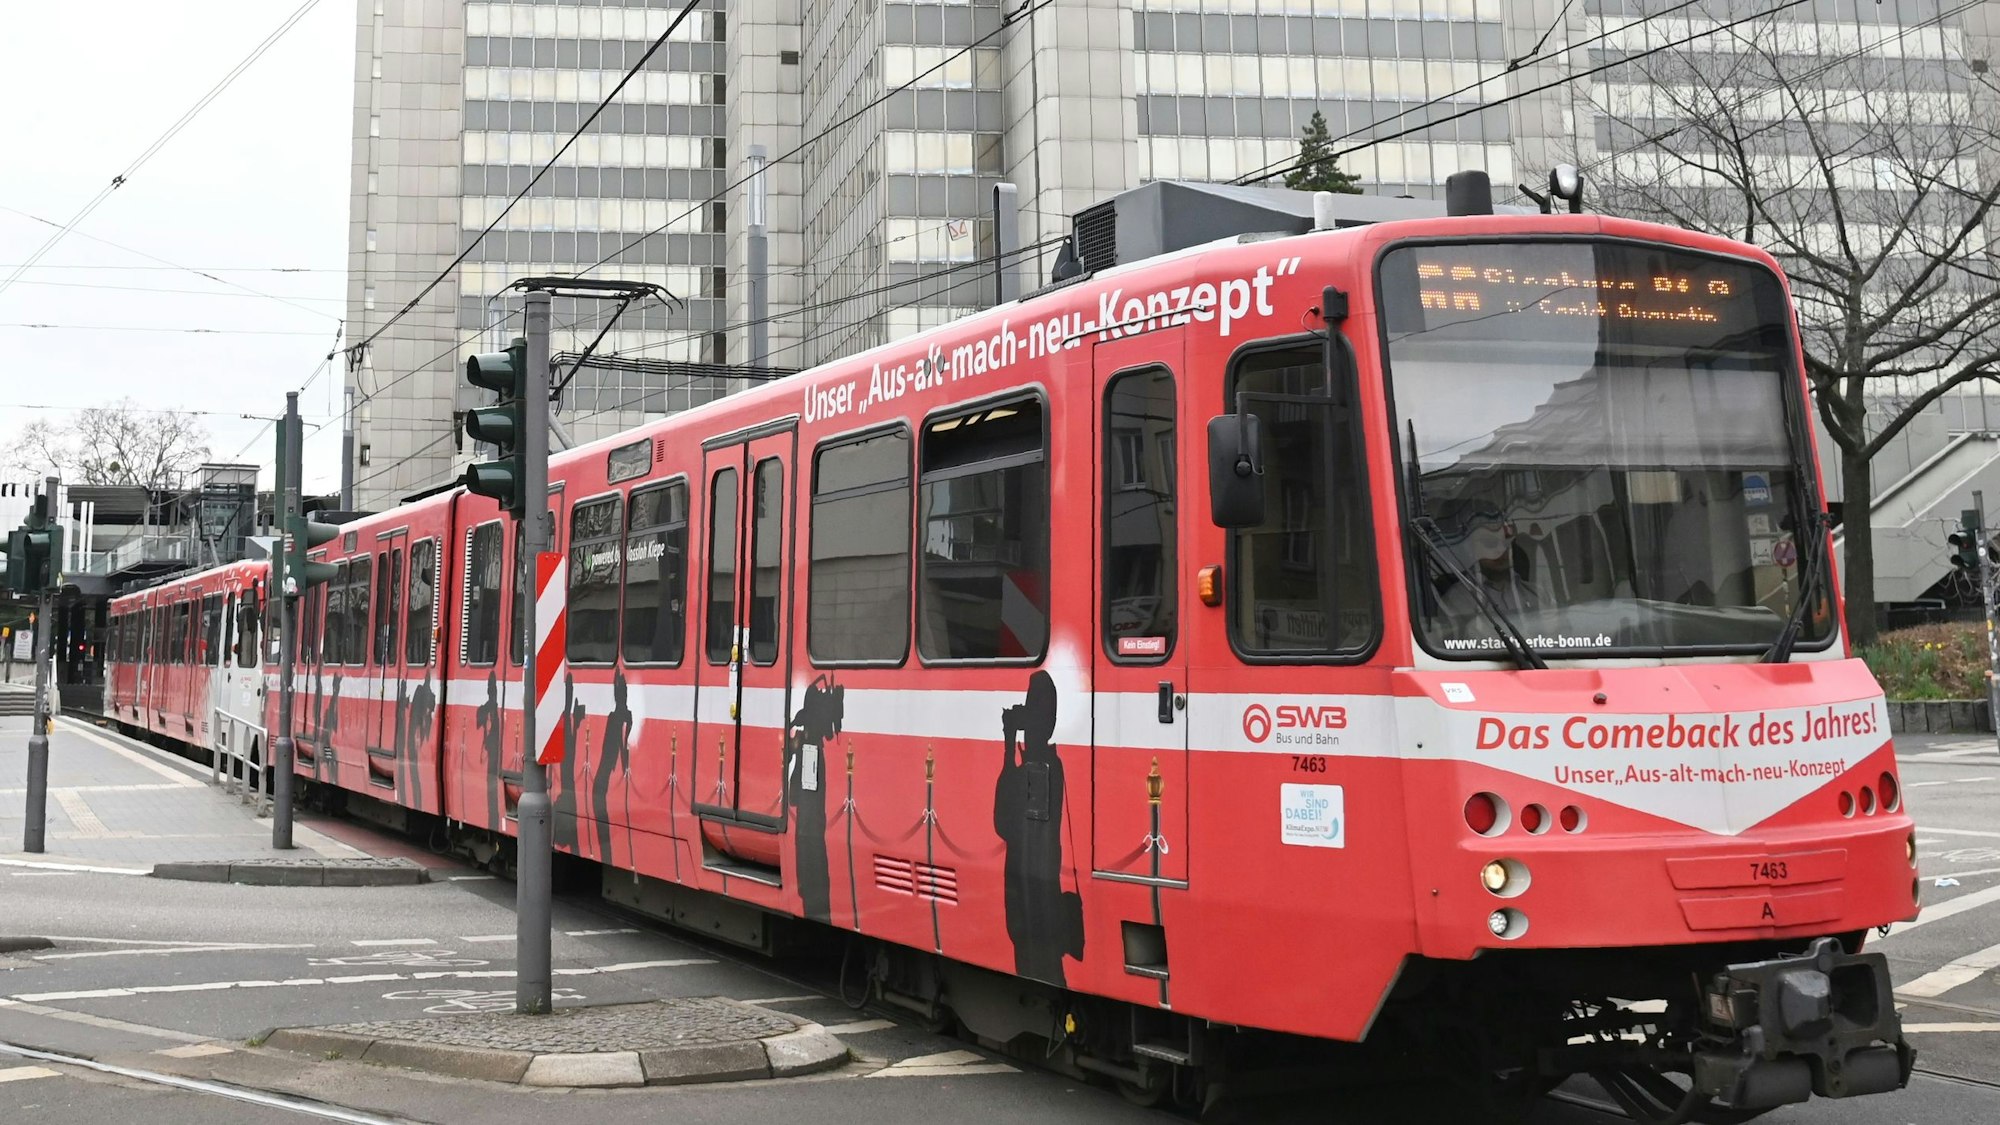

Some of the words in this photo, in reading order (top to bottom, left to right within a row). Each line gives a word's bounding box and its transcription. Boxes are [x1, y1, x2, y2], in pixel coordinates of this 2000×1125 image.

[804, 383, 855, 424] Unser
[1444, 633, 1612, 650] www.staerke-bonn.de
[1276, 705, 1347, 729] SWB
[1476, 716, 1550, 750] Das
[1562, 714, 1740, 750] Comeback
[1748, 712, 1794, 747] des
[1801, 702, 1878, 743] Jahres!
[1276, 733, 1292, 744] Bus
[1295, 733, 1313, 745] und
[1316, 733, 1340, 745] Bahn
[1292, 756, 1327, 773] 7463
[1305, 799, 1329, 809] SIND
[1285, 807, 1322, 821] DABEI!
[1750, 862, 1788, 880] 7463
[1761, 901, 1775, 919] A
